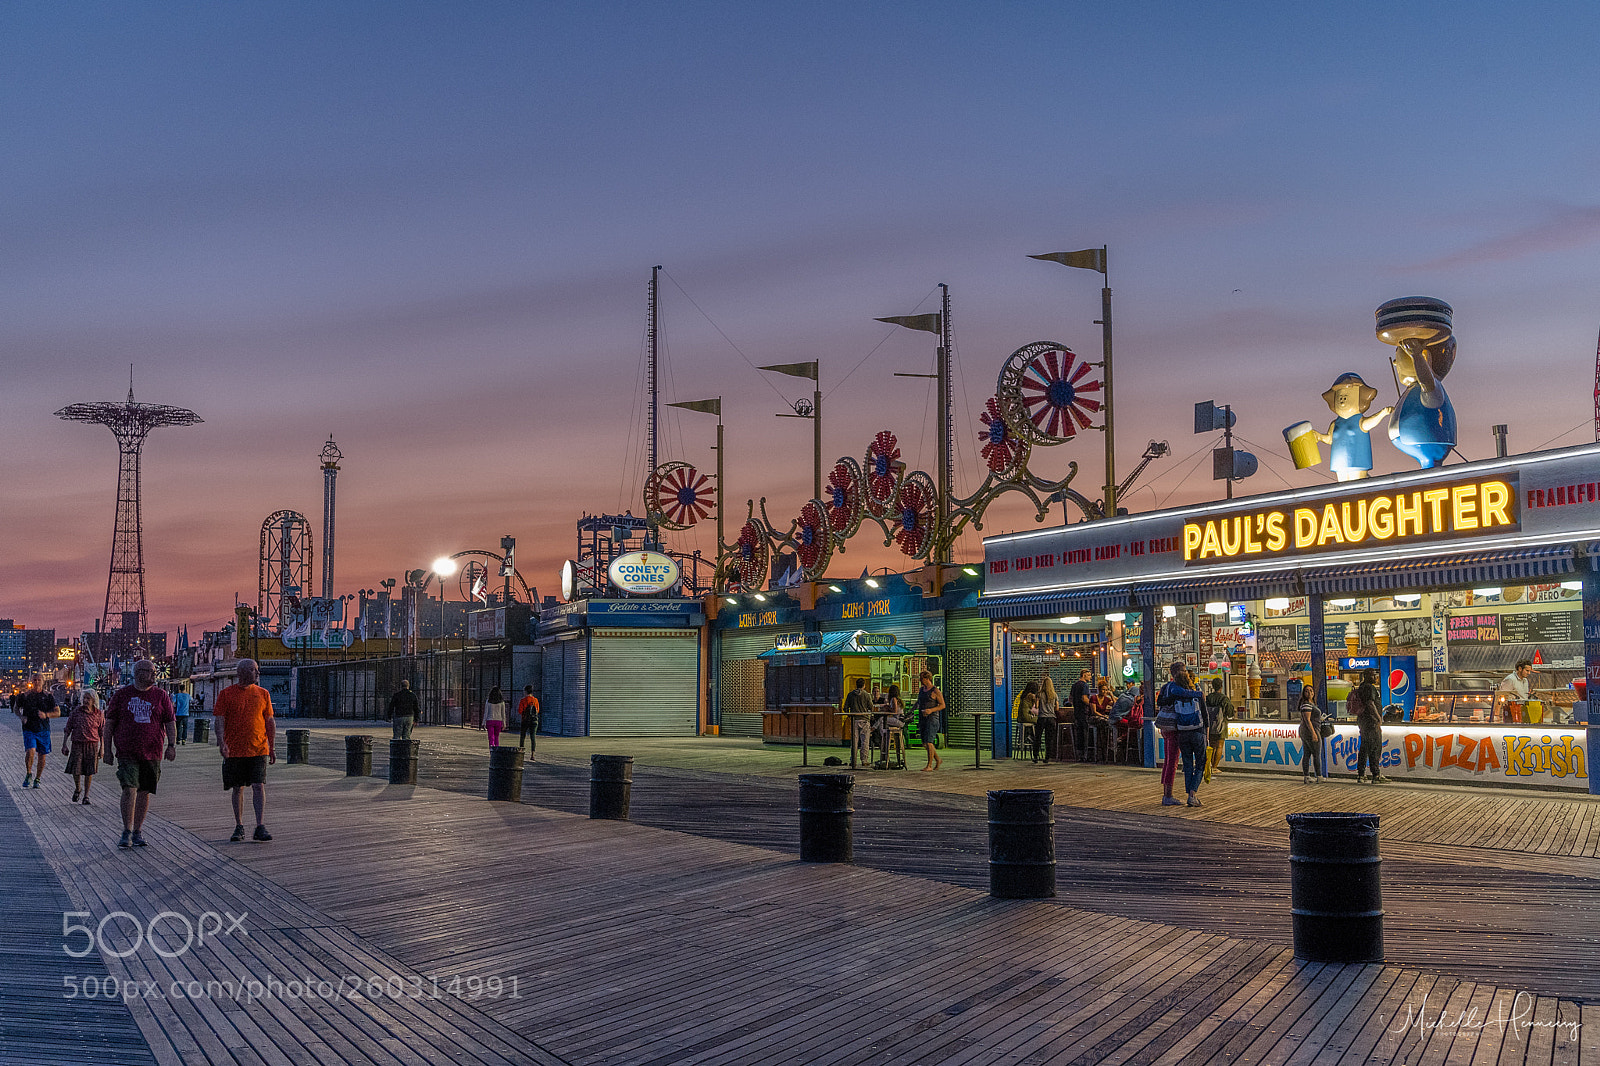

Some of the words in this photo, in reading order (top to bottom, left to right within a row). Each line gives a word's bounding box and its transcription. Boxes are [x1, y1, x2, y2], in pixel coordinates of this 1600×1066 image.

[1527, 482, 1600, 509] FRANKFU
[1183, 511, 1287, 560] PAUL'S
[1294, 480, 1511, 549] DAUGHTER
[990, 559, 1009, 574] FRIES
[1016, 557, 1033, 571] COLD
[1035, 554, 1054, 569] BEER
[1063, 548, 1092, 565] COTTON
[1095, 544, 1121, 561] CANDY
[1130, 541, 1145, 556] ICE
[1149, 536, 1180, 554] CREAM
[618, 565, 670, 574] CONEY'S
[623, 574, 665, 582] CONES
[1538, 591, 1560, 601] HERO
[608, 603, 640, 613] Gelato
[648, 603, 682, 611] Sorbet
[841, 601, 865, 619] LUNA
[867, 599, 891, 617] PARK
[738, 613, 757, 628] LUNA
[758, 610, 778, 626] PARK
[1450, 617, 1474, 630] FRESH
[1477, 616, 1496, 626] MADE
[863, 635, 891, 645] Tickets
[1478, 626, 1500, 641] PIZZA
[1356, 659, 1370, 667] pepsi
[1433, 657, 1444, 665] ICE
[1245, 727, 1268, 738] TAFFY
[1272, 728, 1297, 739] ITALIAN
[1224, 740, 1311, 766] REAM
[1403, 733, 1501, 775] PIZZA
[1503, 735, 1588, 778] Knish
